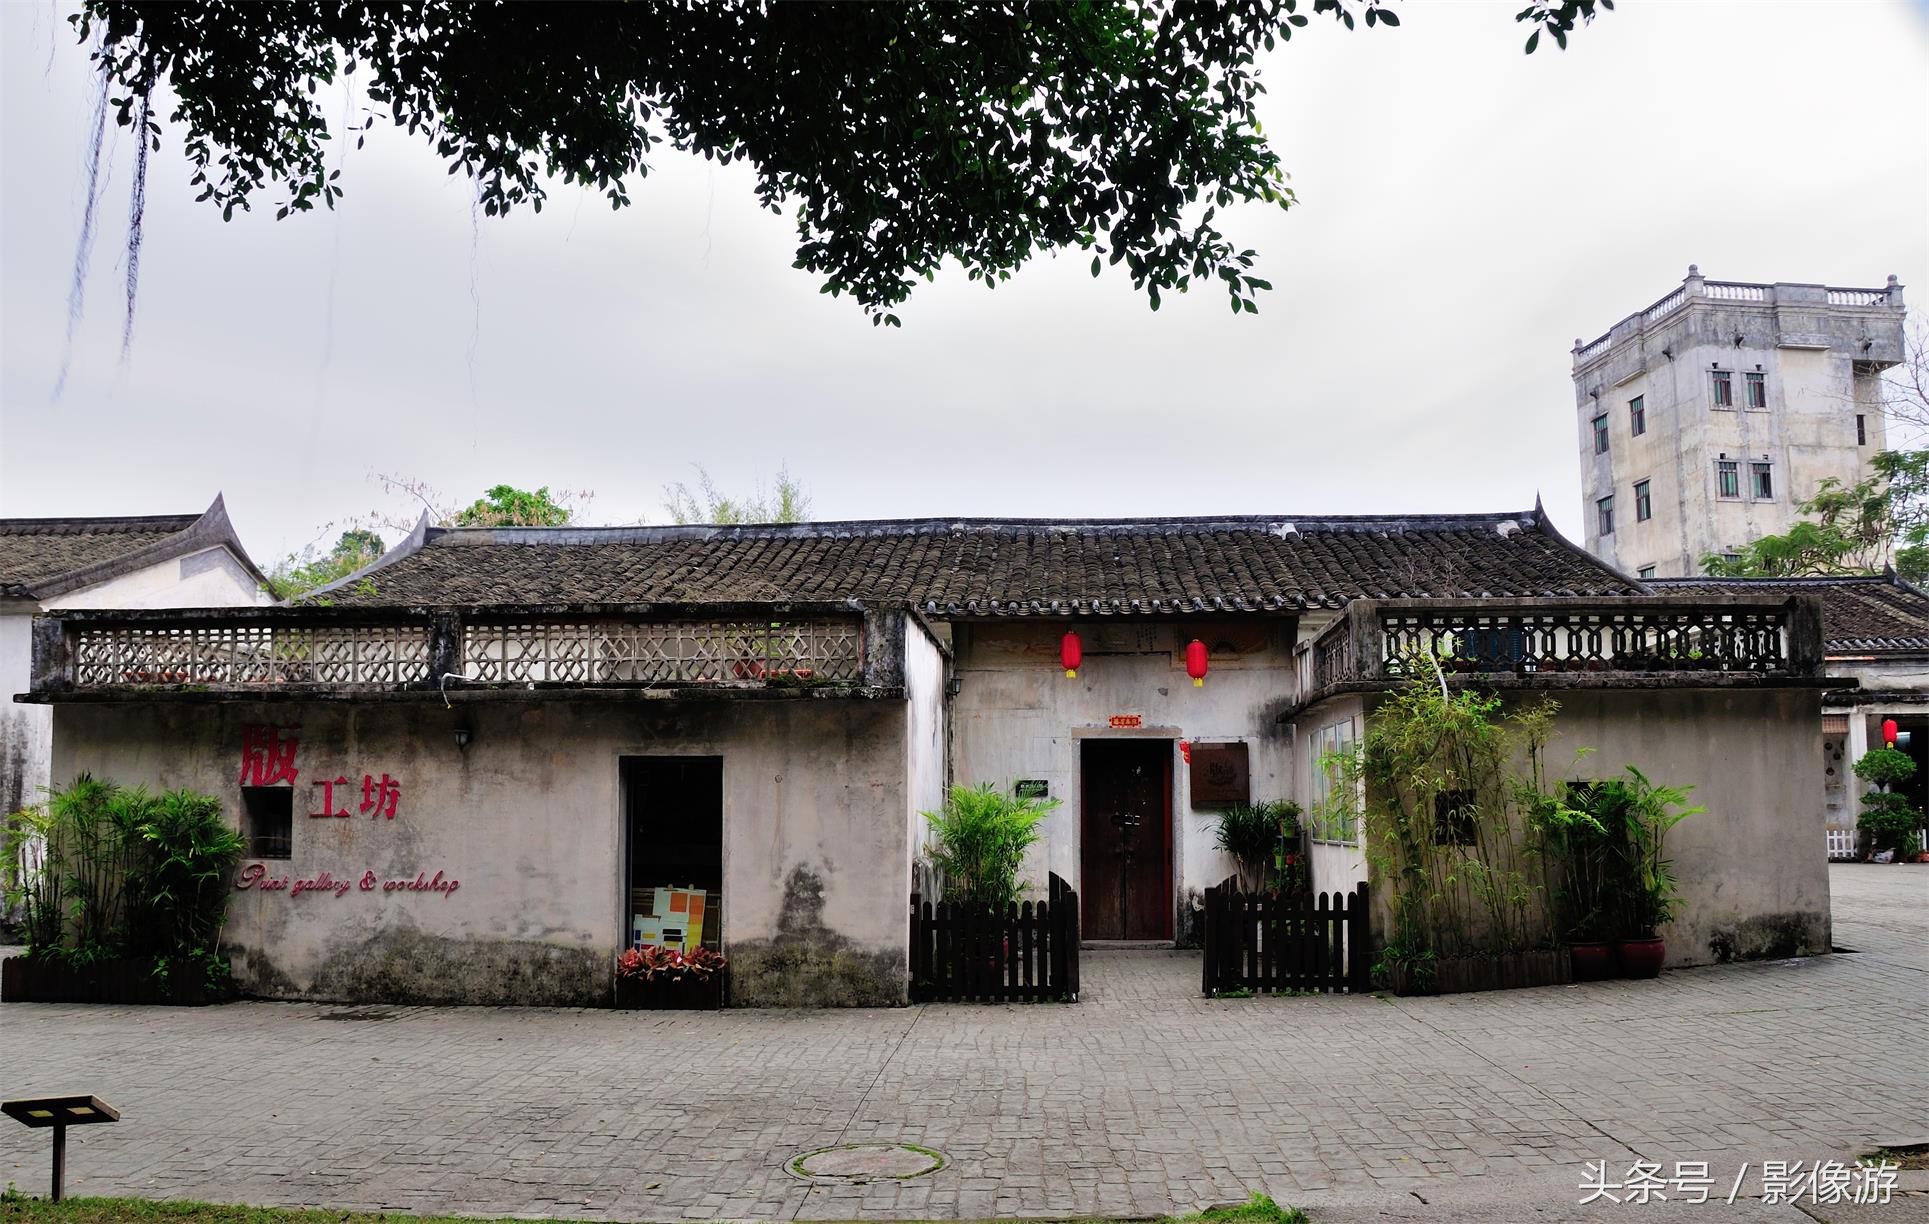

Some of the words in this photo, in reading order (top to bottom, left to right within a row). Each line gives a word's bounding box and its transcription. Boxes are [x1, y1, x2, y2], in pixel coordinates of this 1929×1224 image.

[239, 724, 300, 786] 版
[309, 774, 401, 820] 工坊
[235, 864, 288, 891] Print
[290, 873, 350, 897] gallery
[359, 871, 377, 892] &
[383, 871, 461, 898] workshop
